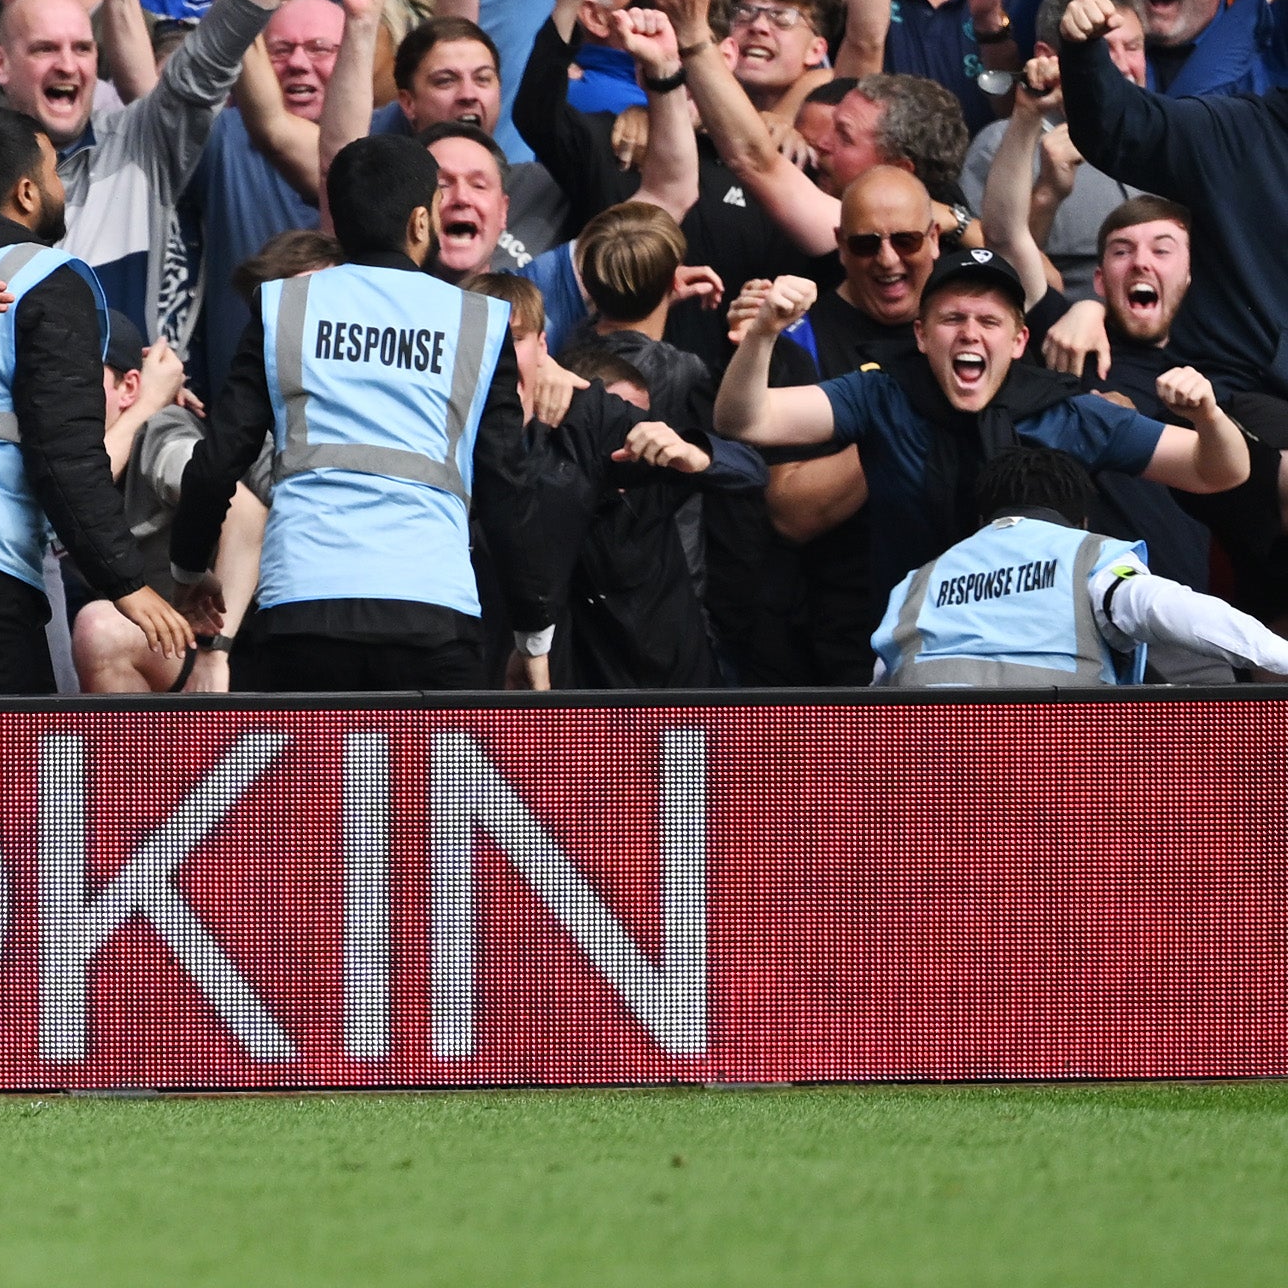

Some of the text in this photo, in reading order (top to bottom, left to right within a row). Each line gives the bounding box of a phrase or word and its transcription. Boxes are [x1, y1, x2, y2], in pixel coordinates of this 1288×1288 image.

[314, 319, 445, 375] RESPONSE
[936, 558, 1058, 608] RESPONSE TEAM
